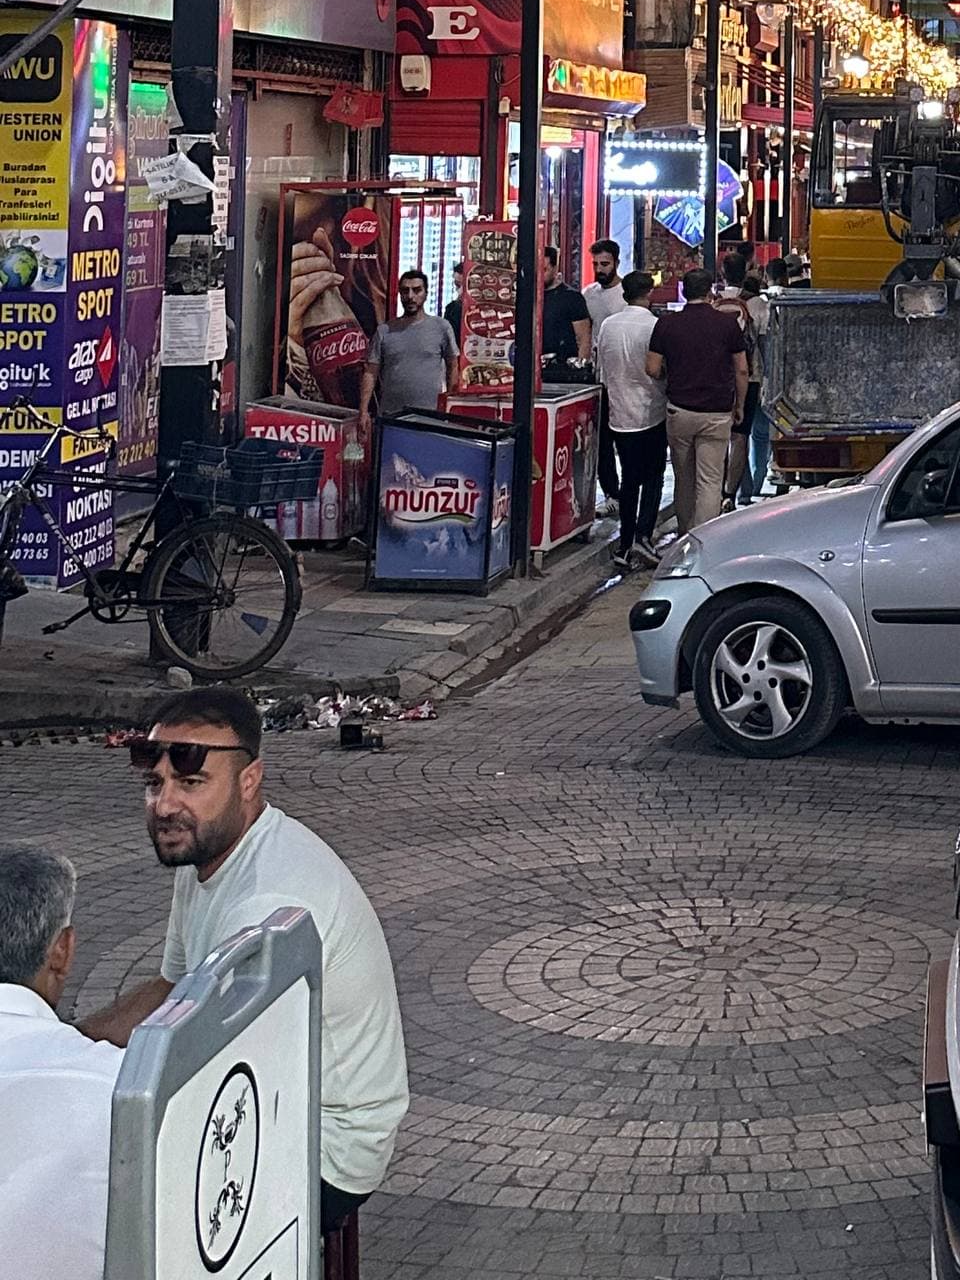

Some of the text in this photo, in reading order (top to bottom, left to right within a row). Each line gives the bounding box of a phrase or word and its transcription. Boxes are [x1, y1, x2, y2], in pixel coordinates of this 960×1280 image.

[14, 129, 62, 141] UNION
[3, 163, 46, 171] Buradan
[14, 188, 37, 196] Para
[0, 213, 60, 223] pabilirsiniz!
[72, 248, 120, 282] METRO
[0, 303, 57, 323] ETRO
[77, 288, 113, 321] SPOT
[68, 339, 99, 370] aras
[74, 367, 94, 385] cargo
[67, 401, 80, 420] GEL
[82, 398, 91, 415] AL
[251, 420, 336, 443] TAKSİM
[66, 489, 112, 524] NOKTASI
[386, 489, 480, 513] munzur
[21, 533, 48, 543] 40 03
[84, 525, 97, 545] 212
[23, 549, 34, 559] 73
[36, 549, 49, 559] 65
